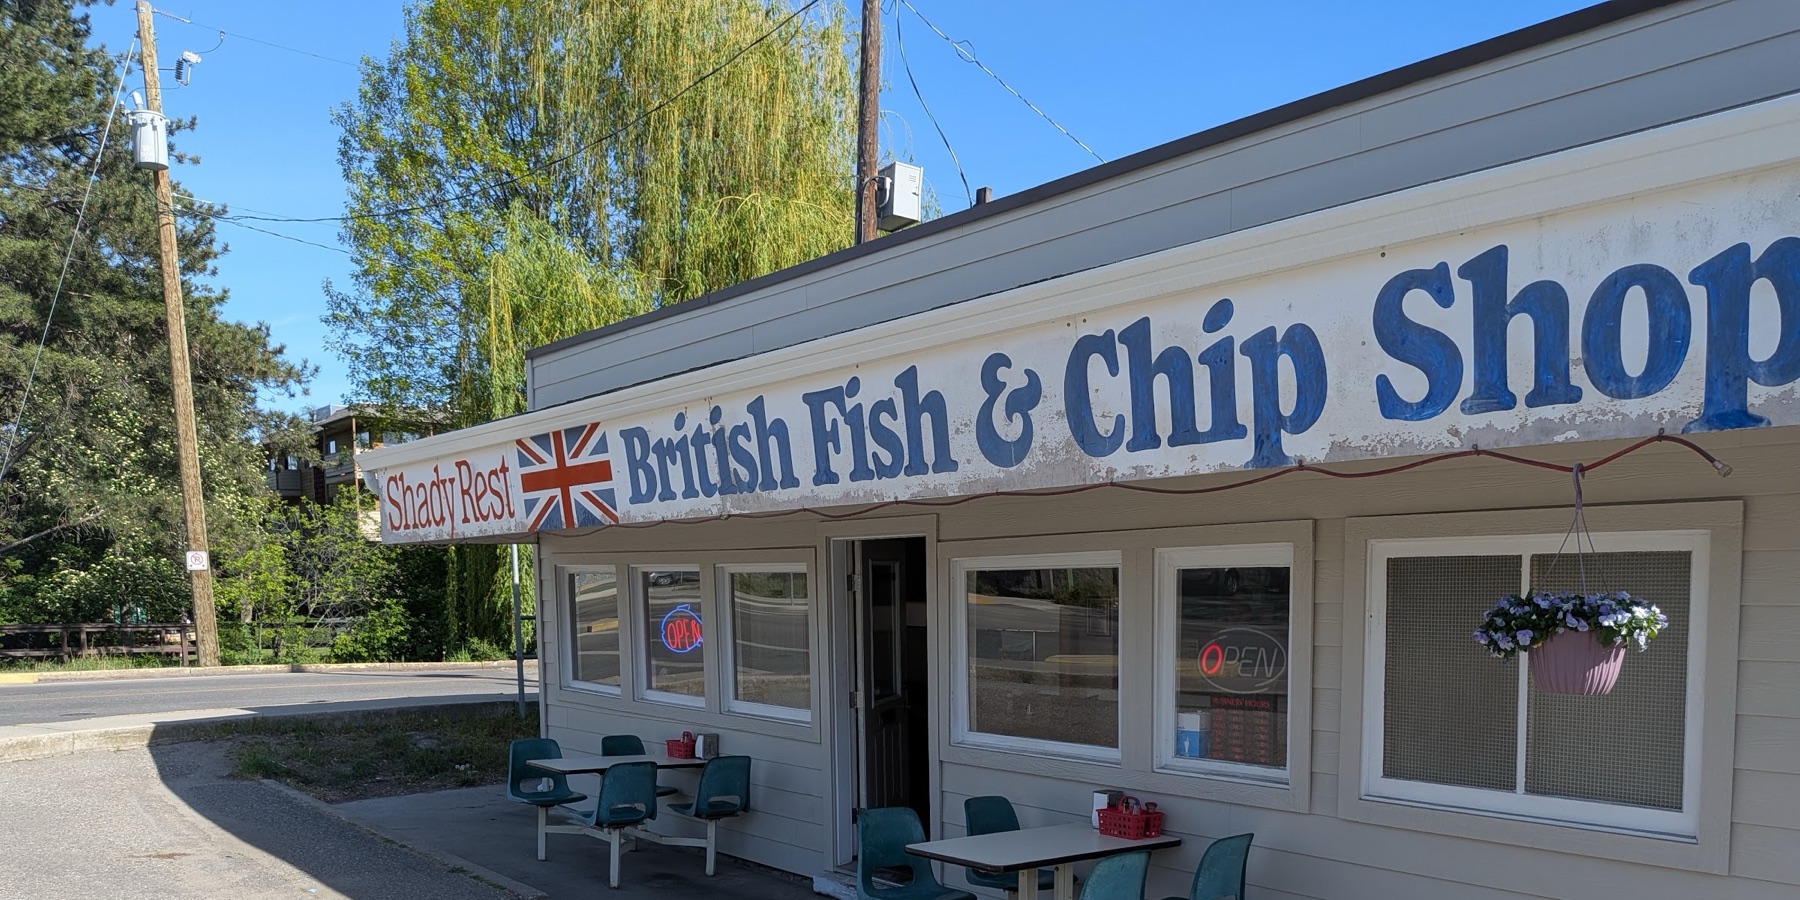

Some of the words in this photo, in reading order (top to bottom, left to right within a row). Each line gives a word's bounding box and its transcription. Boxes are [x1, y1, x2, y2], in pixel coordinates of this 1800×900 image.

[619, 394, 800, 505] British
[802, 364, 958, 487] Fish
[975, 352, 1042, 469] &
[1063, 298, 1328, 470] Chip
[1373, 236, 1800, 435] Shop
[387, 464, 455, 539] Shady
[455, 455, 515, 523] Rest
[668, 618, 701, 649] OPEN
[1202, 644, 1277, 677] OPEN
[1212, 697, 1243, 706] BUSINESS
[1245, 698, 1270, 708] HOURS
